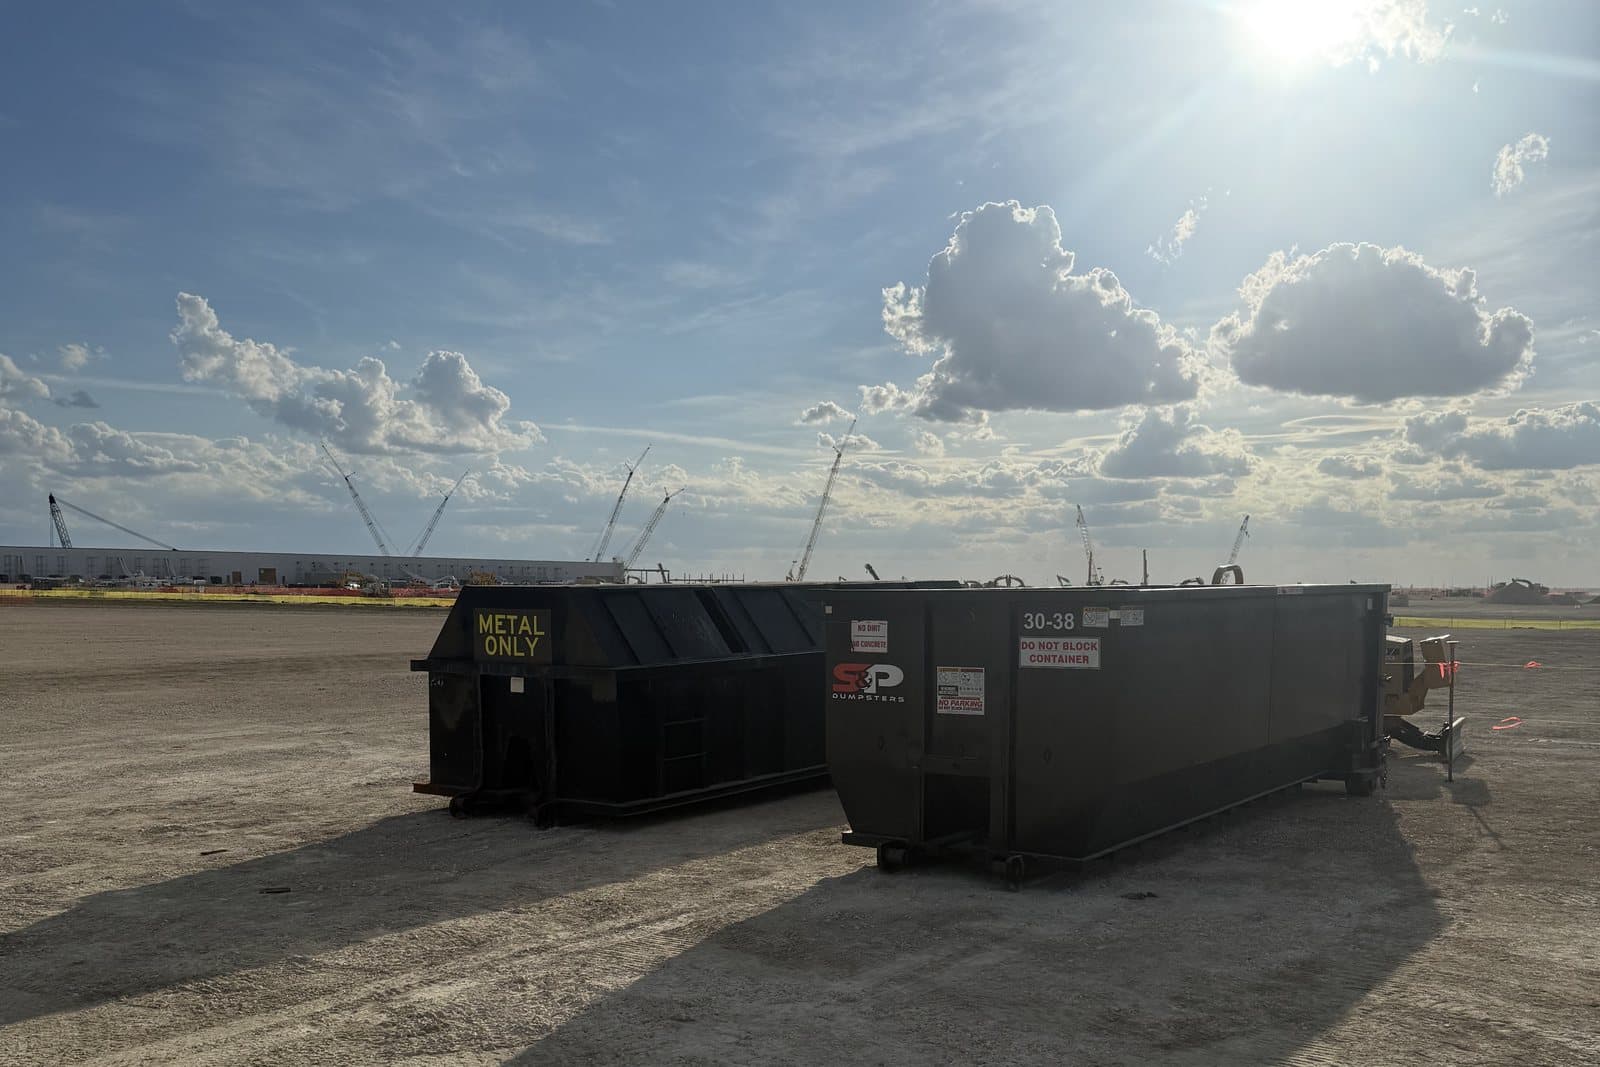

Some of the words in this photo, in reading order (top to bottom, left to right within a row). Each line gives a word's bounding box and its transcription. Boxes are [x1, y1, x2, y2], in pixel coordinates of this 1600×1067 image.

[479, 614, 545, 635] METAL
[1023, 613, 1075, 630] 30-38
[857, 624, 866, 632] NO
[485, 635, 539, 656] ONLY
[1021, 641, 1036, 650] DO
[1038, 641, 1060, 650] NOT
[1062, 642, 1098, 651] BLOCK
[1029, 654, 1089, 664] CONTAINER
[832, 663, 904, 694] S&P
[832, 692, 905, 703] DUMPSTERS
[950, 700, 983, 708] PARKING
